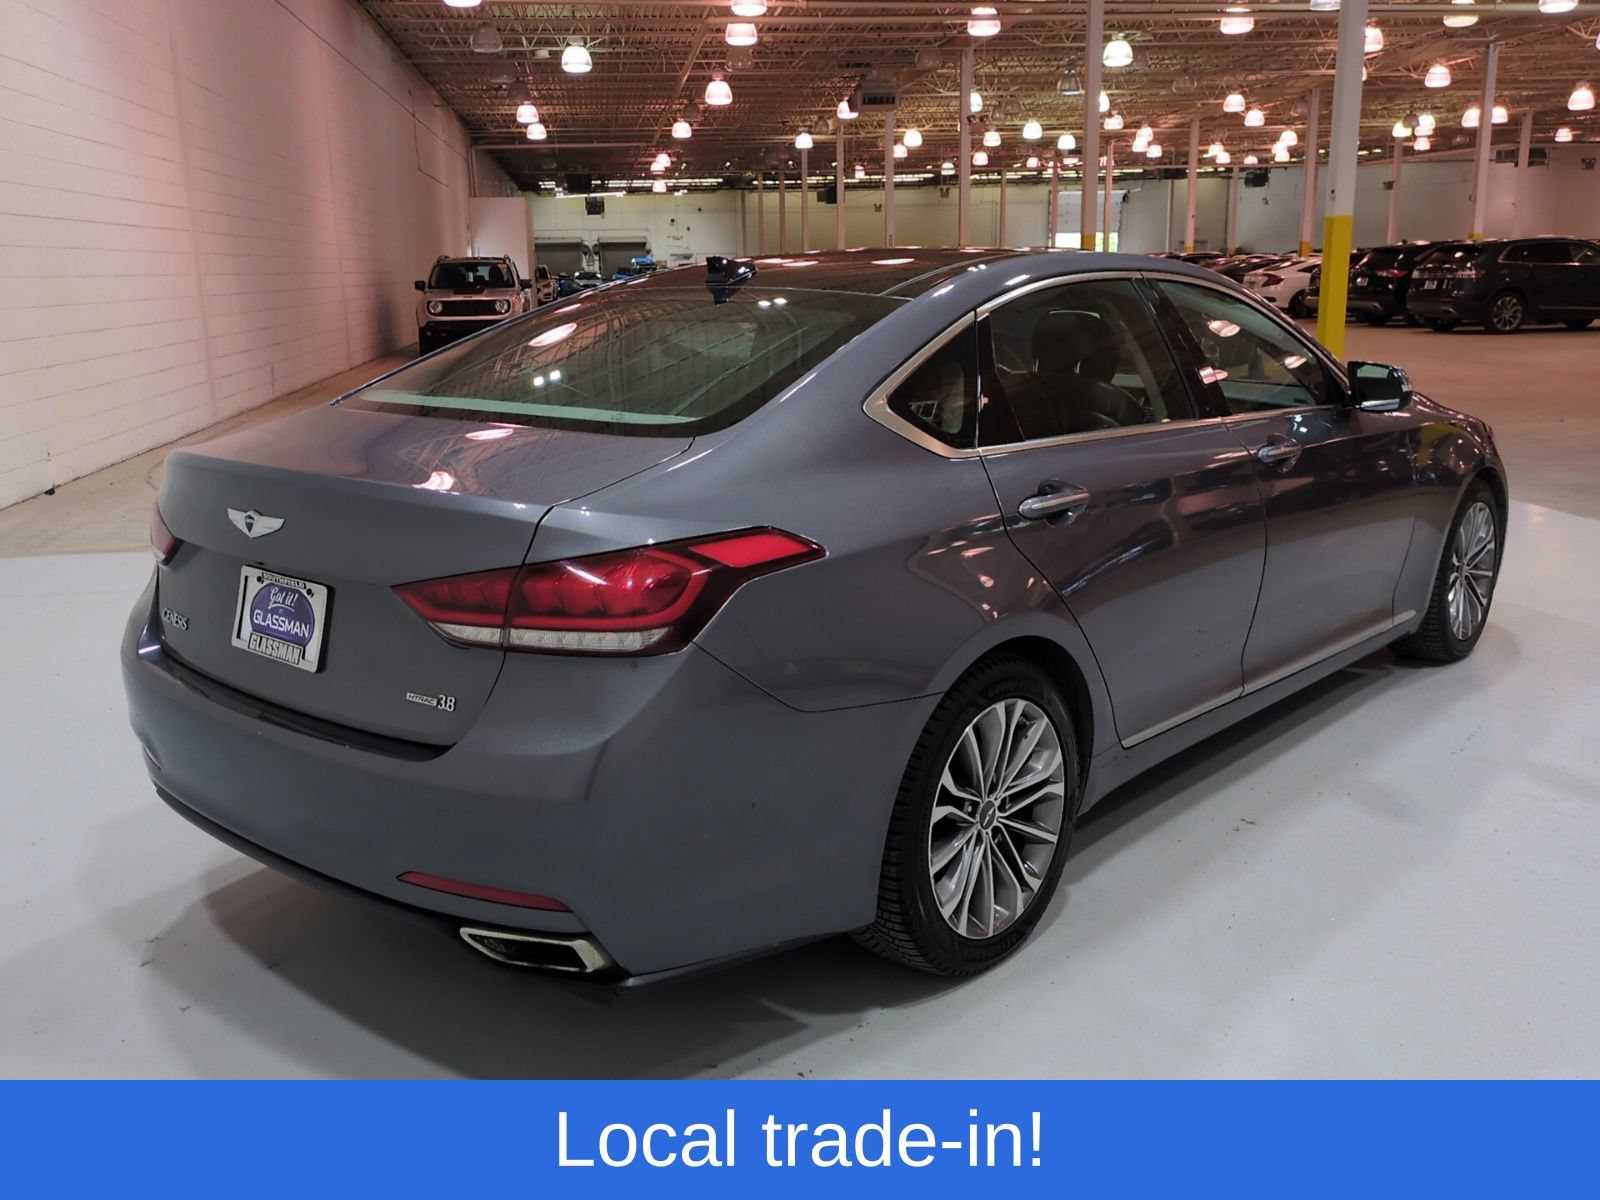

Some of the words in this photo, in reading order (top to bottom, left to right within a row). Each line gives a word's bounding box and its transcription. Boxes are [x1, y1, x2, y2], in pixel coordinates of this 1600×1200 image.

[269, 587, 286, 604] Got
[285, 591, 299, 607] it!
[253, 609, 310, 638] GLASSMAN
[249, 633, 301, 664] GLASSMAN
